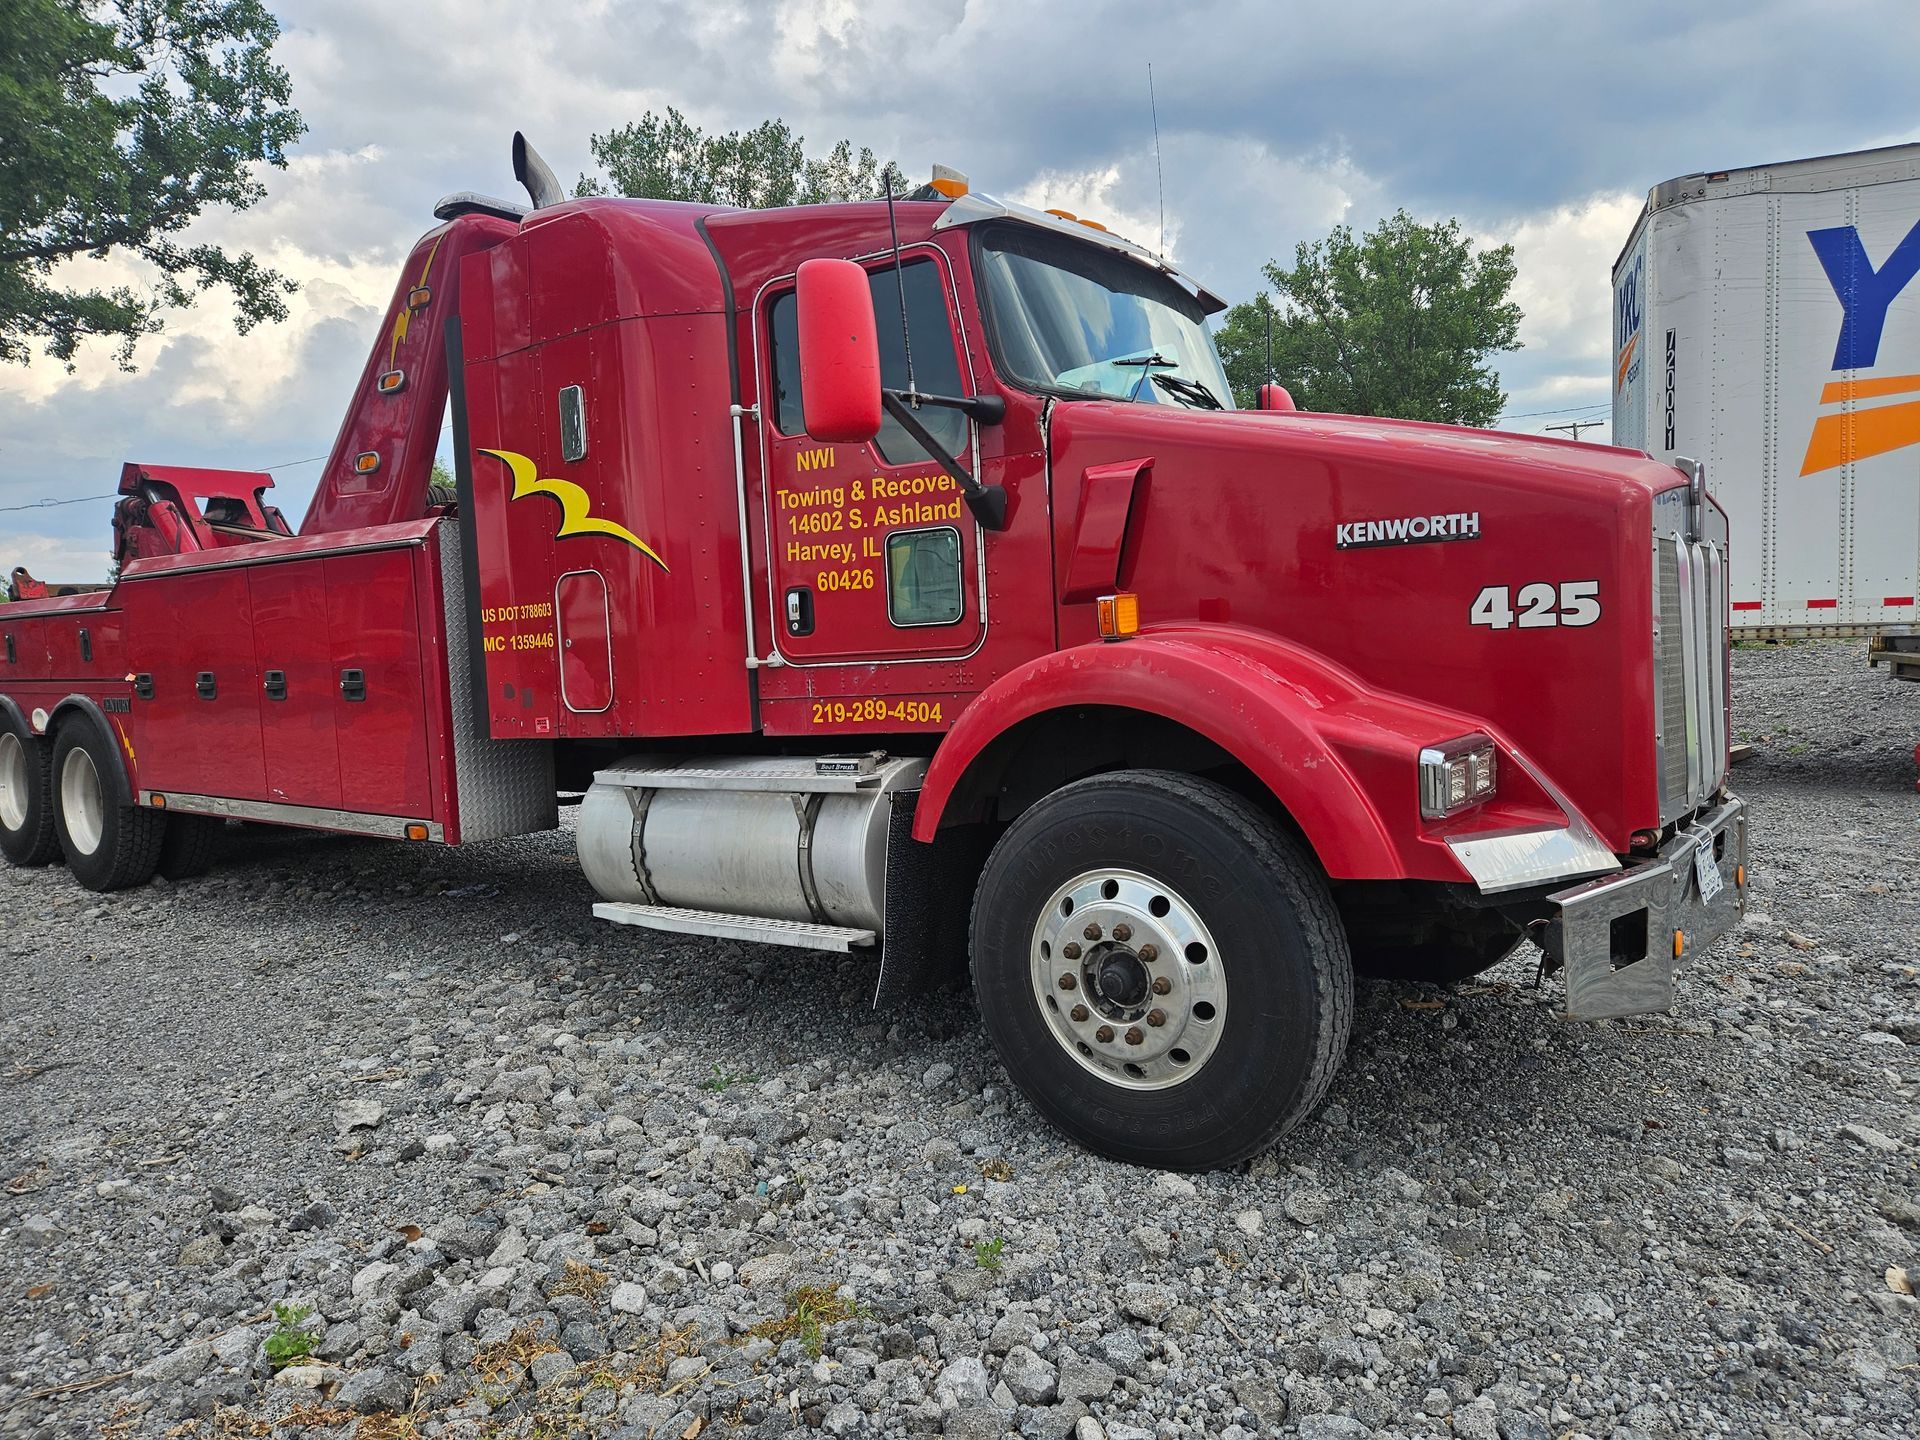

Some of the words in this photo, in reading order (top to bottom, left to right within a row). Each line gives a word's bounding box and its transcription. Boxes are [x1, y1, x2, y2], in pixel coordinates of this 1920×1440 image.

[1619, 255, 1642, 349] YRC
[1806, 216, 1920, 371] Y
[1666, 329, 1676, 449] 720001
[797, 448, 835, 472] NWI
[777, 486, 845, 510] Towing
[850, 480, 865, 501] &
[872, 474, 966, 499] Recover
[789, 510, 843, 535] 14602
[849, 508, 868, 530] S.
[873, 497, 961, 527] Ashland
[1336, 512, 1479, 544] KENWORTH
[787, 541, 857, 563] Harvey,
[863, 537, 882, 557] IL
[817, 569, 874, 592] 60426
[482, 608, 496, 622] US
[498, 606, 519, 621] DOT
[521, 603, 551, 617] 3788603
[1470, 580, 1602, 629] 425
[484, 636, 506, 652] MC
[510, 633, 554, 649] 1359446
[812, 699, 942, 724] 219-289-4504
